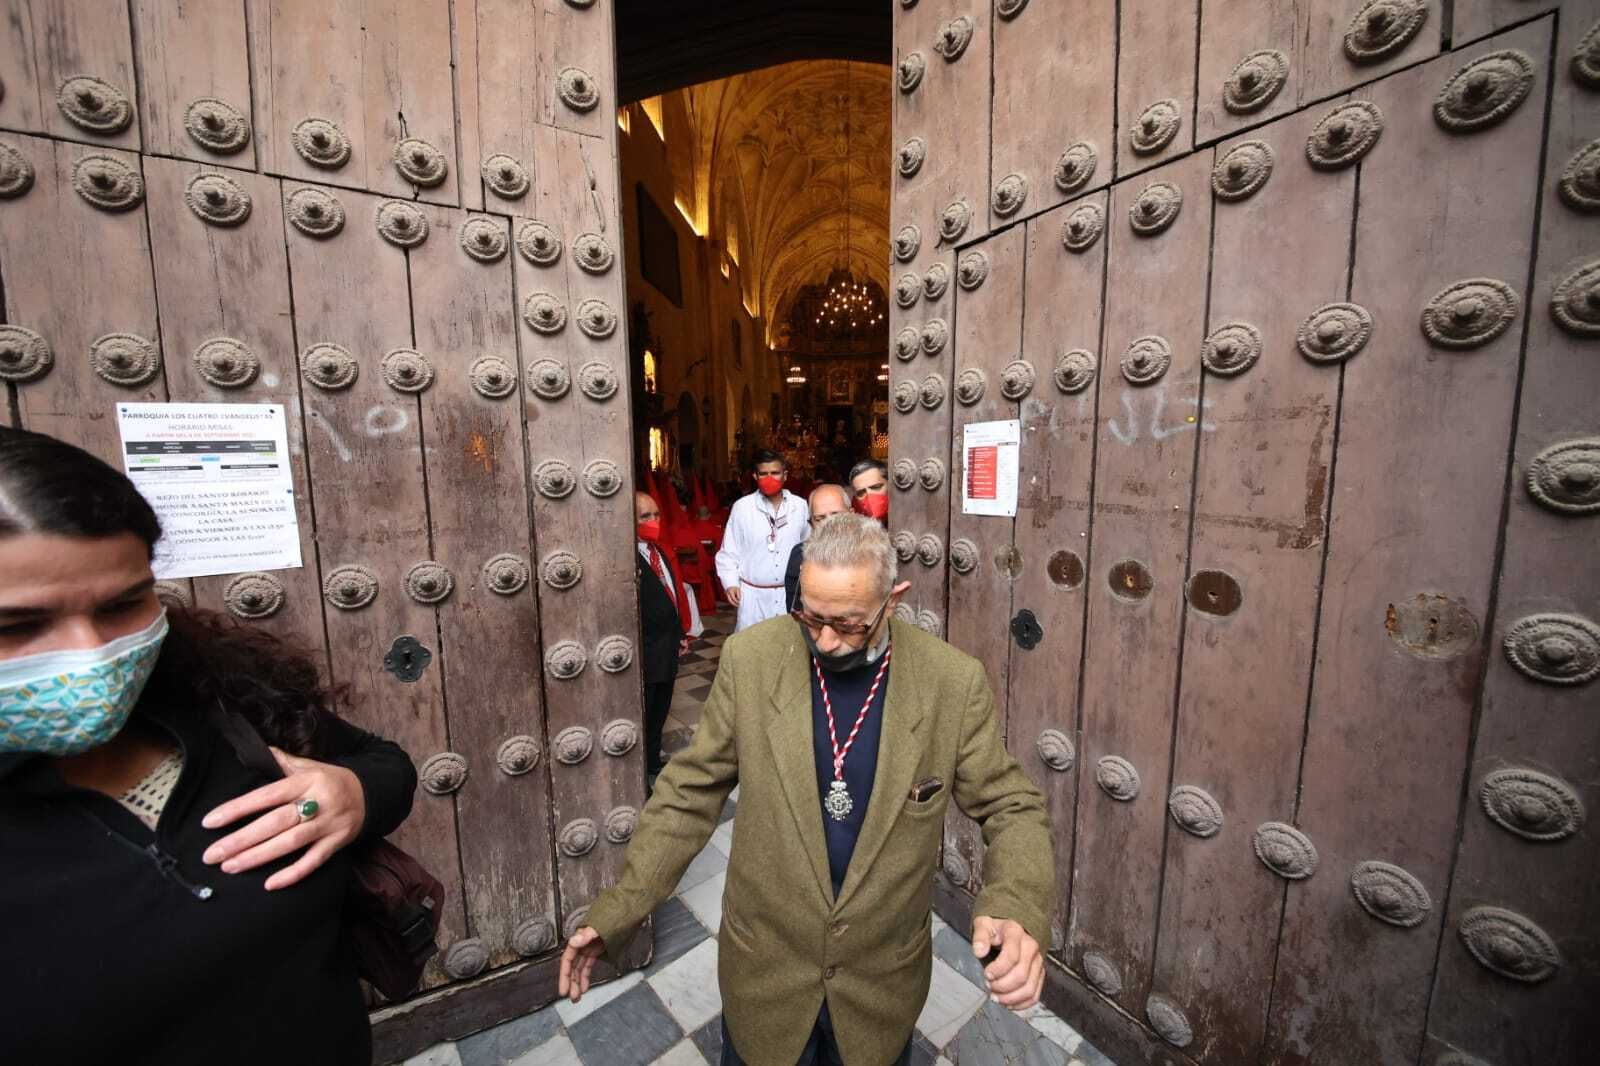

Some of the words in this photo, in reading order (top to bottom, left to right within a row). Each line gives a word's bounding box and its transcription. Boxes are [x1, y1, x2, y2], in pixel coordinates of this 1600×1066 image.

[122, 412, 170, 420] PARROQUIA
[171, 412, 186, 420] LOS
[187, 412, 218, 420] CUATRO
